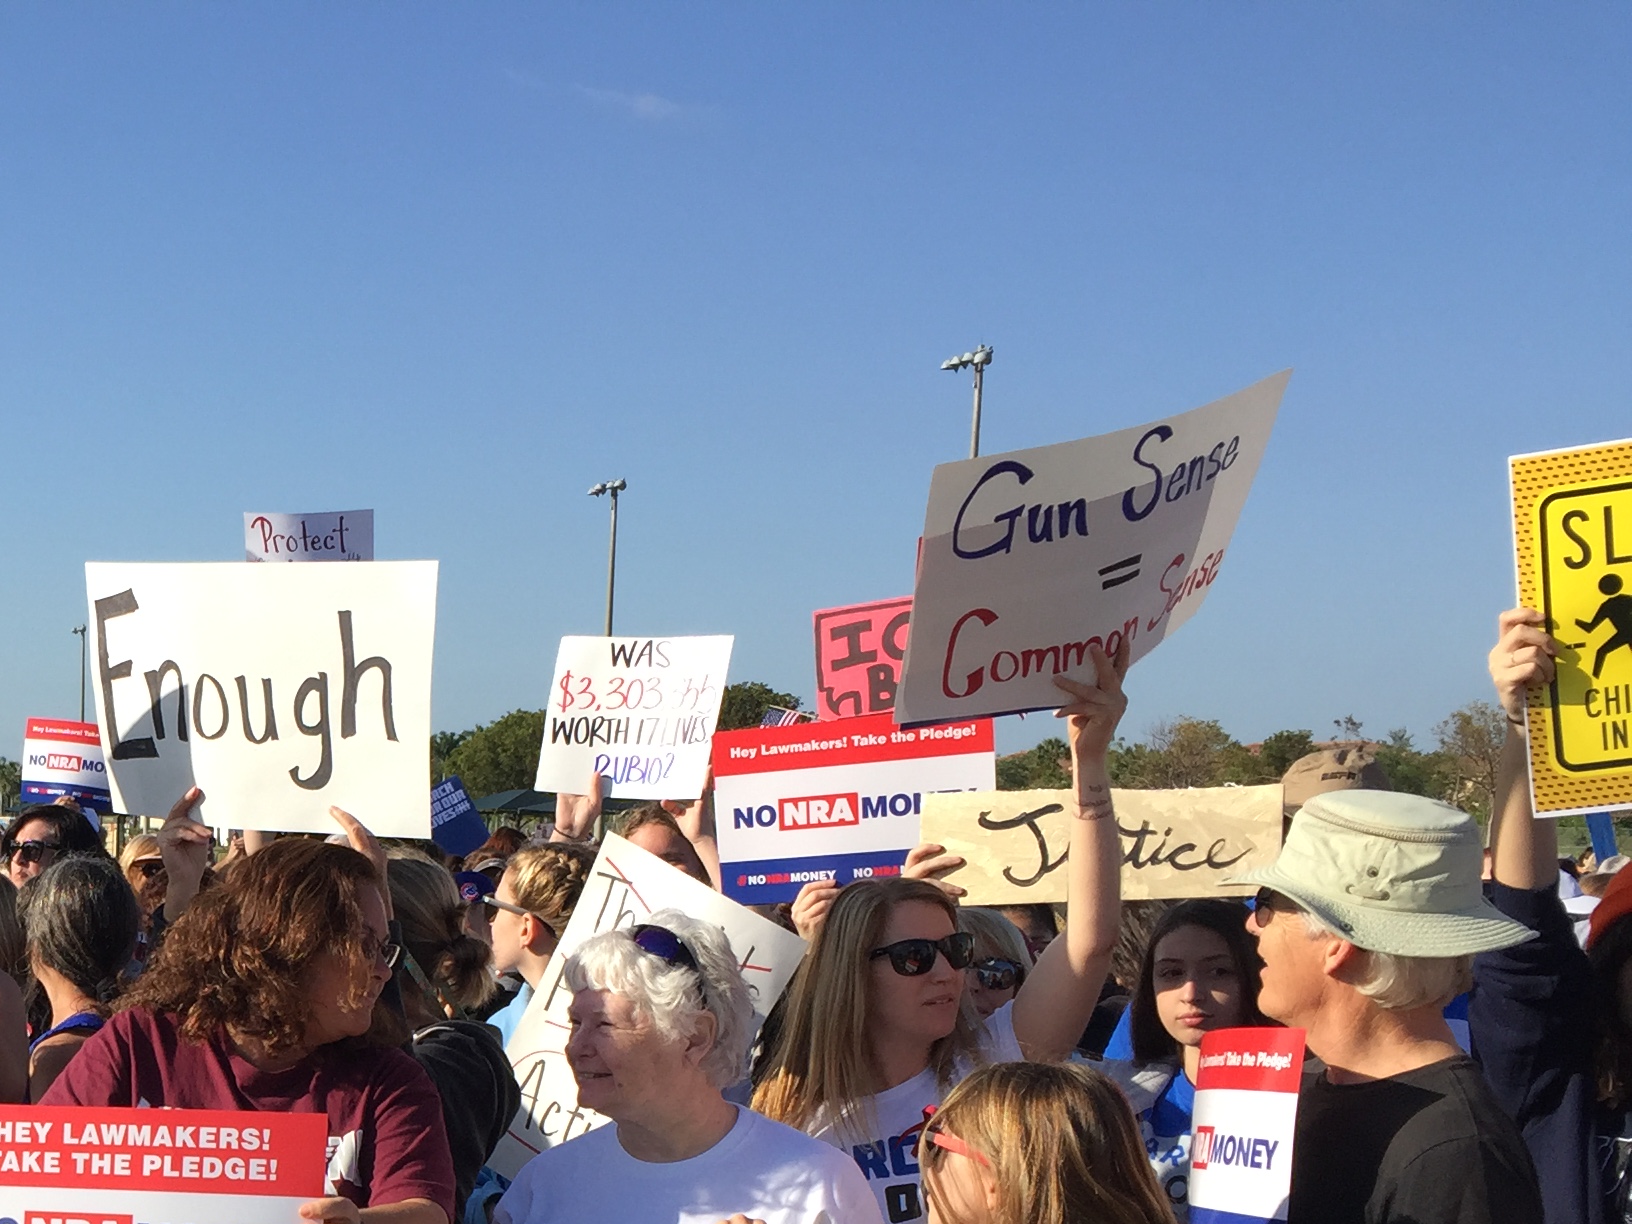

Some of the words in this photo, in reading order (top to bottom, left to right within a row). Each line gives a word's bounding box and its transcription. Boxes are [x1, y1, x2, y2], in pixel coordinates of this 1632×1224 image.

[953, 459, 1088, 560] Gun
[1121, 424, 1240, 522] Sense
[251, 515, 350, 554] Protect
[942, 608, 1140, 699] Common
[1147, 547, 1225, 632] Sense
[611, 640, 671, 668] WAS
[94, 587, 399, 790] Enough
[551, 715, 630, 748] WORTH
[730, 745, 757, 760] Hey
[761, 737, 848, 756] Lawmakers!
[851, 733, 887, 747] Take
[891, 730, 916, 743] the
[919, 724, 977, 740] Pledge!
[1602, 719, 1630, 752] IN
[29, 755, 47, 766] NO
[48, 755, 79, 770] NRA
[733, 805, 777, 830] NO
[783, 801, 856, 827] NRA
[1256, 1052, 1293, 1071] Pledge!
[62, 1122, 272, 1151] LAWMAKERS!
[1210, 1134, 1279, 1170] MONEY
[72, 1152, 132, 1176] THE
[141, 1154, 279, 1182] PLEDGE!
